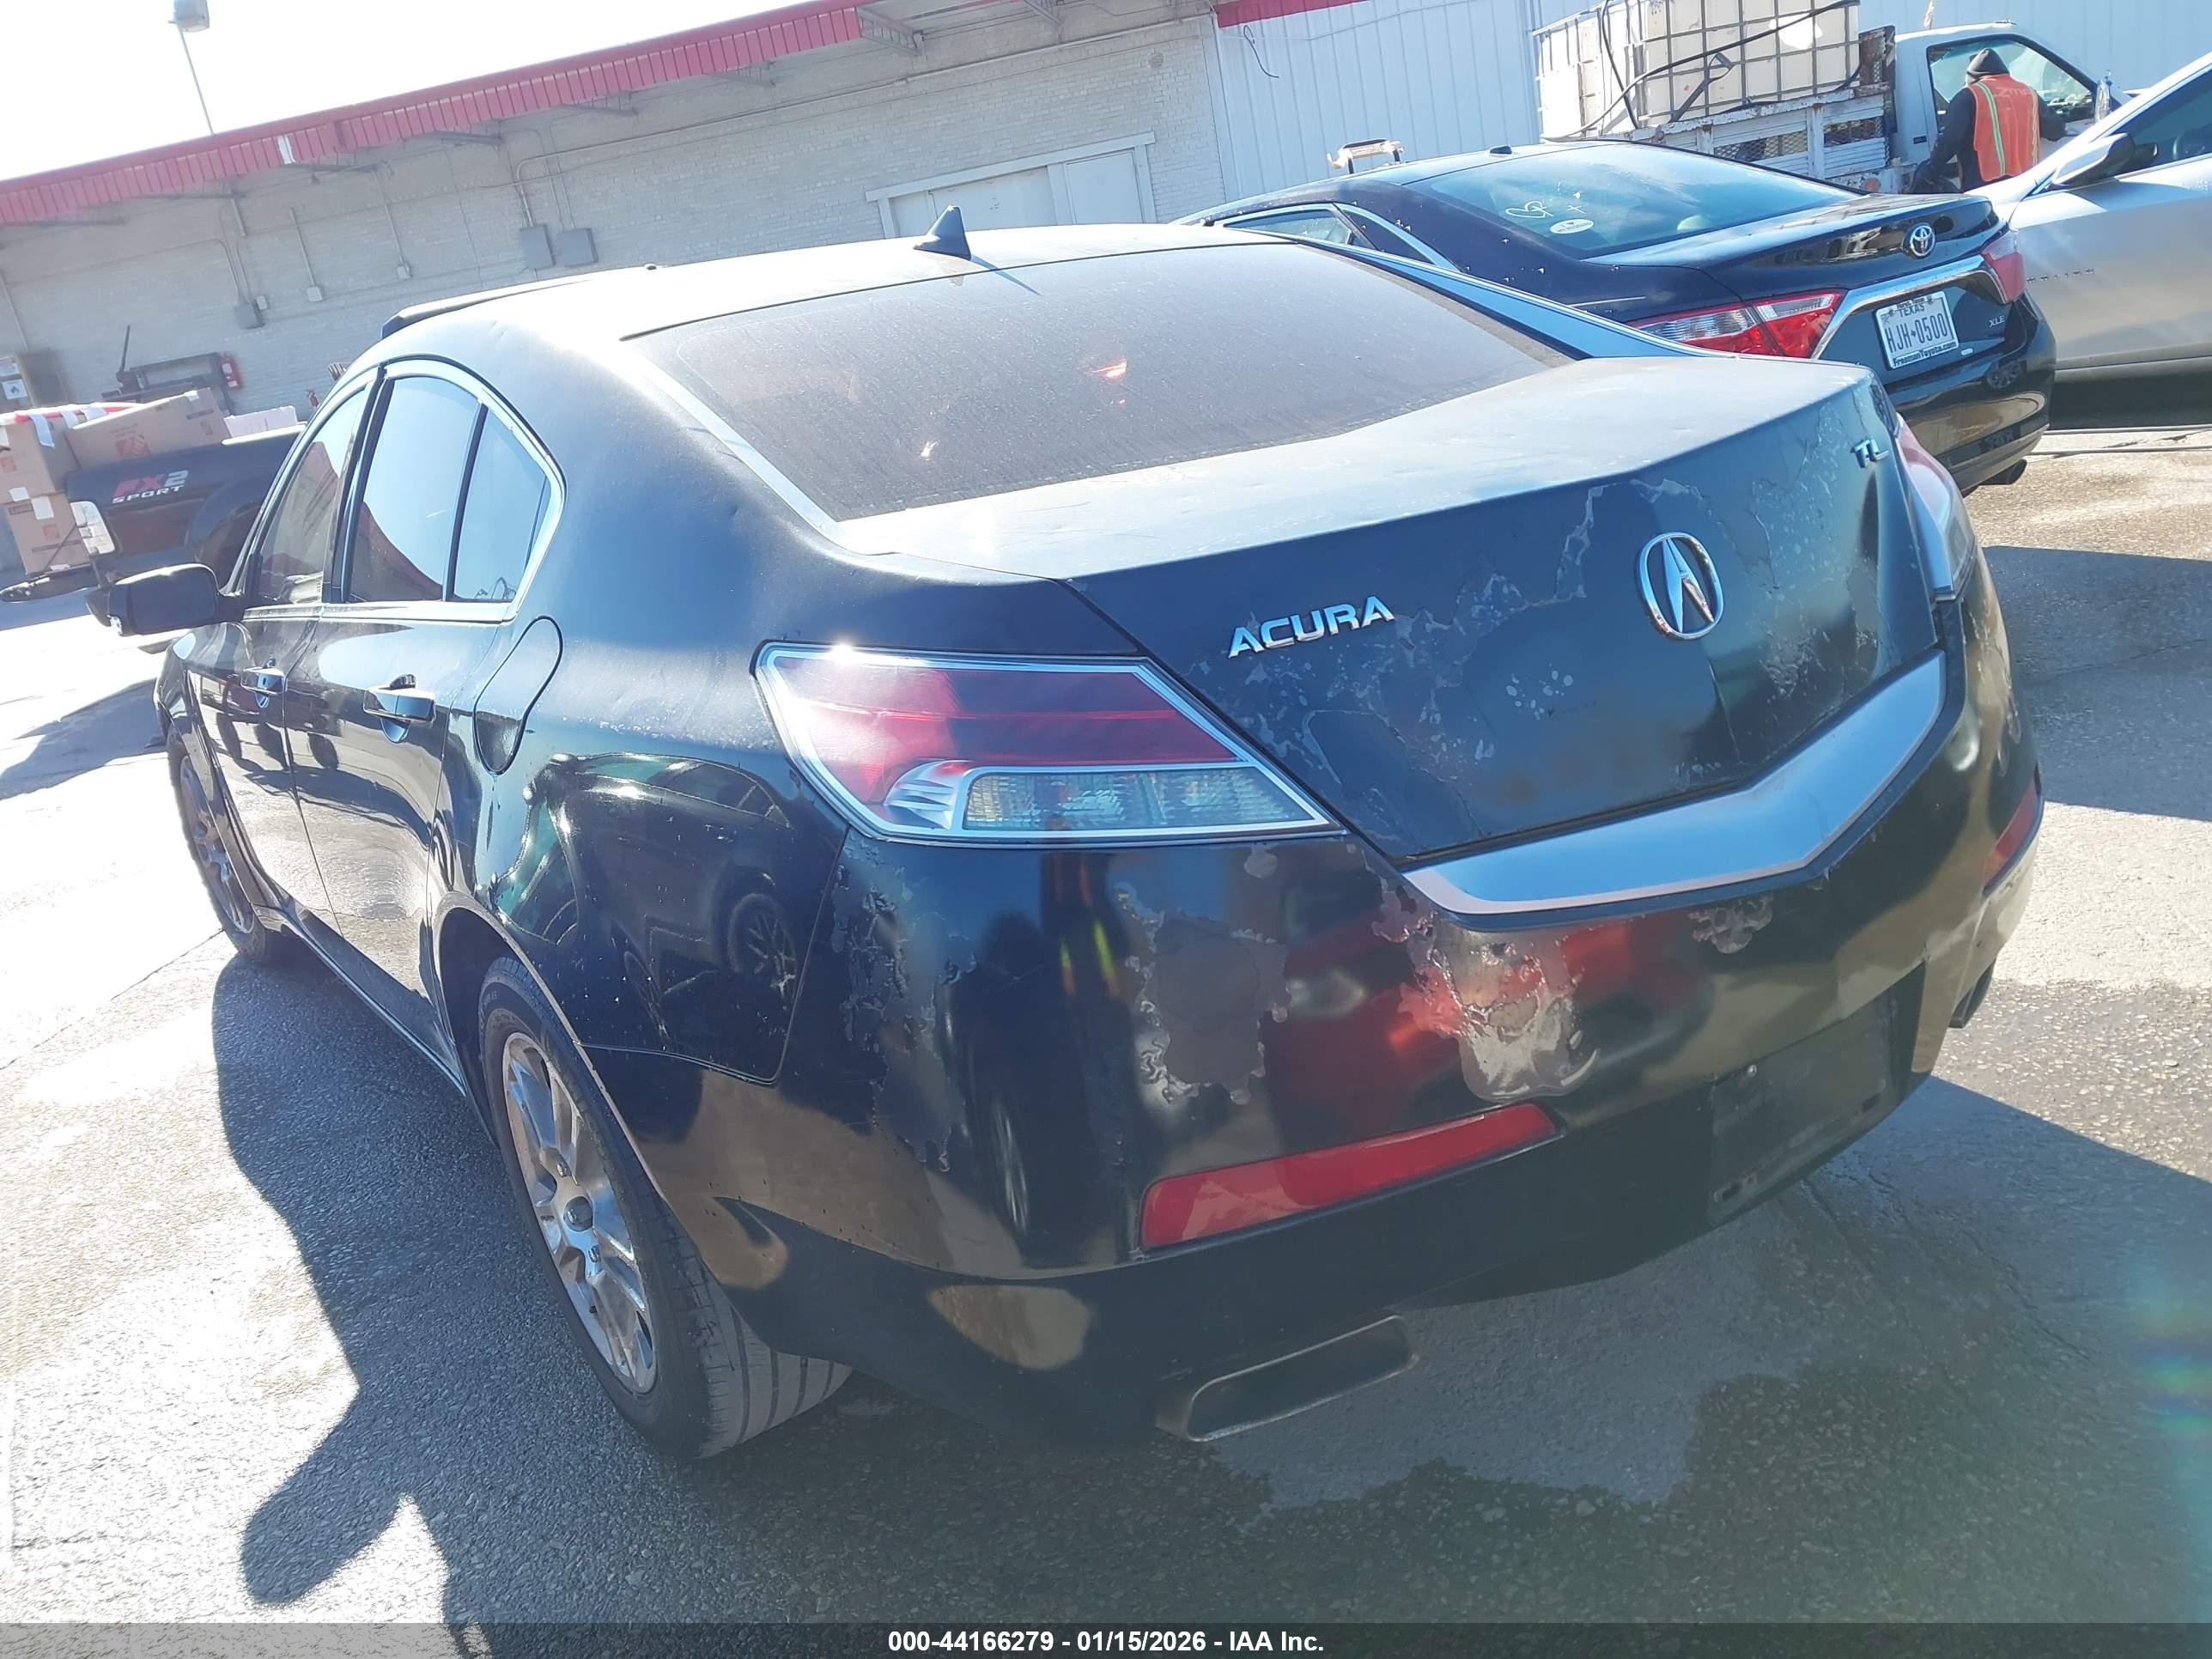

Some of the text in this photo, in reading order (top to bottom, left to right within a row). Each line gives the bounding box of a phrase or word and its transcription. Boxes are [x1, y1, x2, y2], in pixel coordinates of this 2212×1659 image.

[1899, 303, 1925, 318] TEXAS
[1988, 314, 2005, 328] XLE
[1850, 439, 1889, 469] TL
[111, 484, 185, 505] SPORT
[1227, 595, 1395, 659] ACURA
